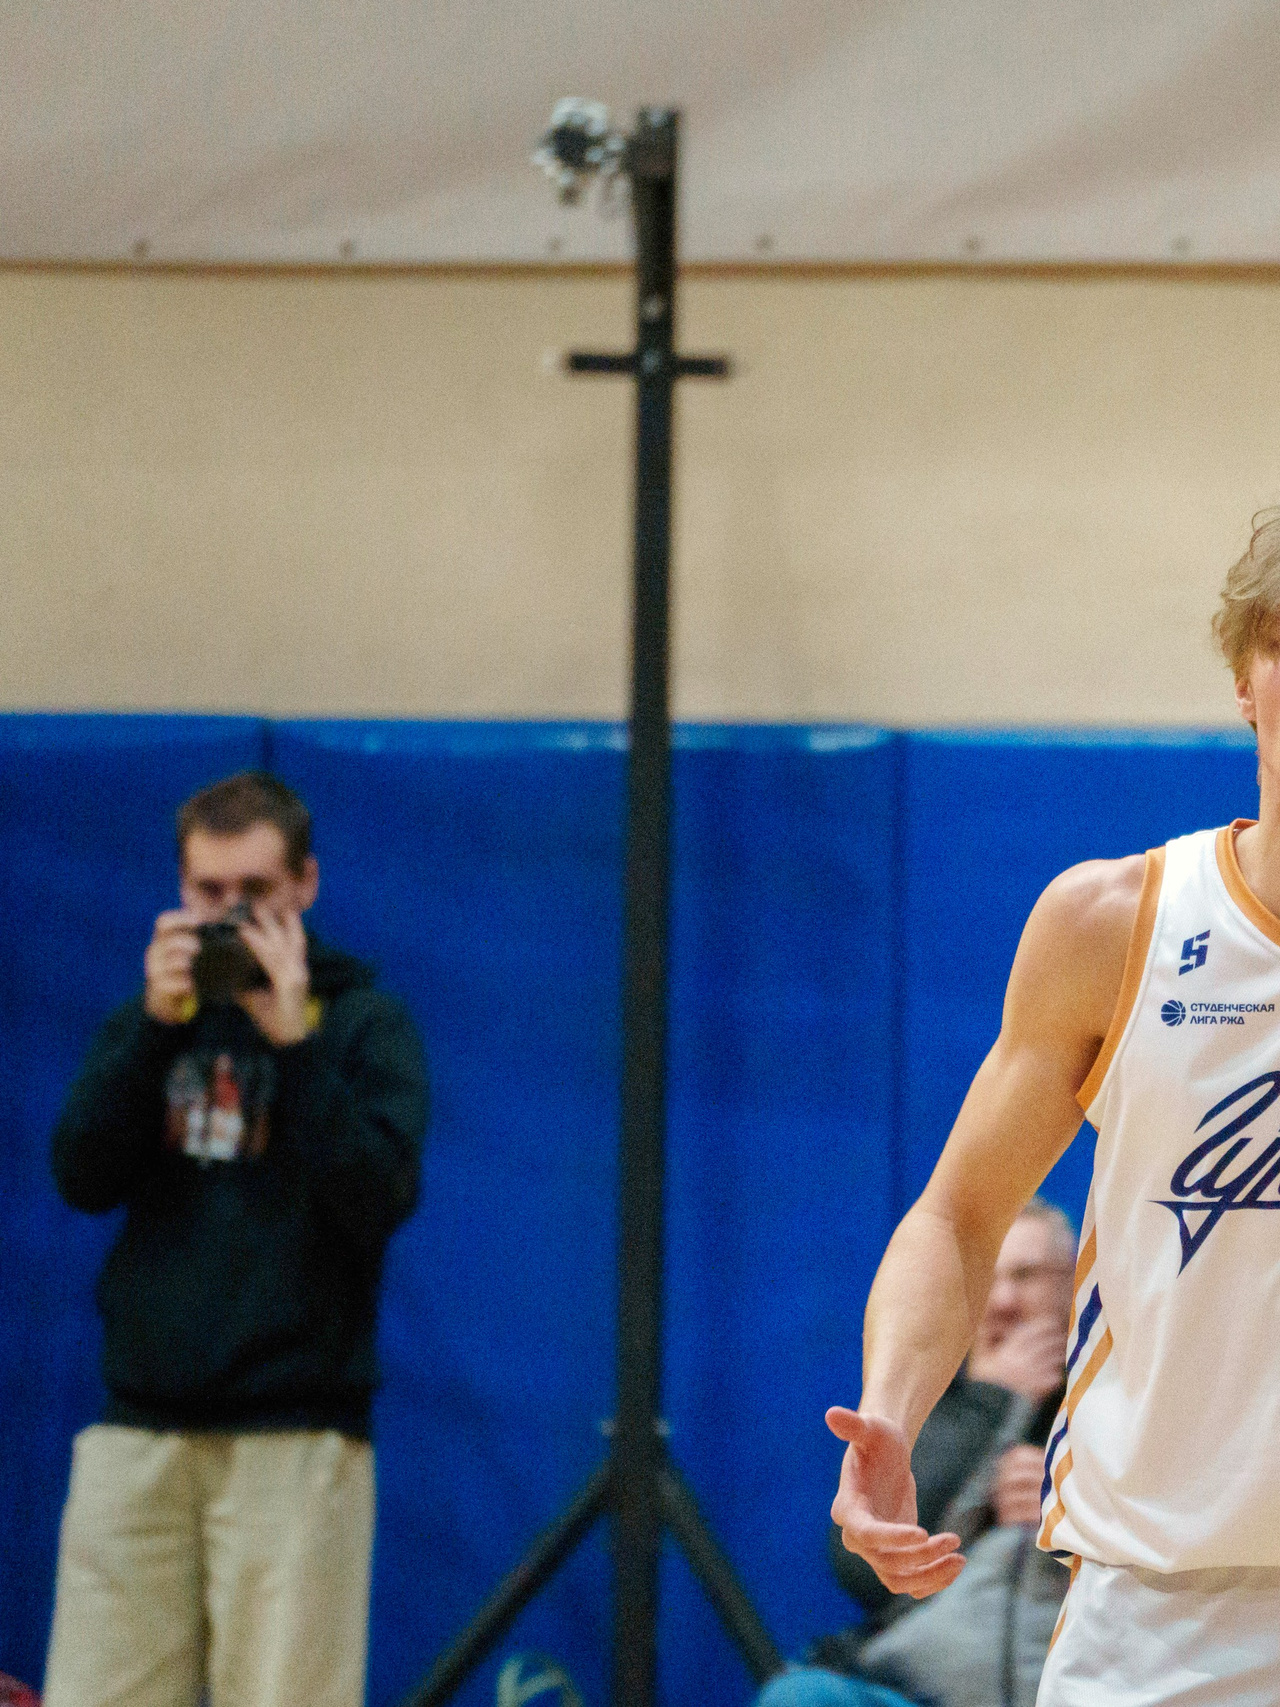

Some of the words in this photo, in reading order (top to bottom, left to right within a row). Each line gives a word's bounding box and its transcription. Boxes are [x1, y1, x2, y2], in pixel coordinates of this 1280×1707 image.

[1190, 1002, 1275, 1013] СТУДЕНЧЕСКАЯ
[1189, 1015, 1218, 1025] ЛИГА
[1220, 1016, 1245, 1025] РЖД
